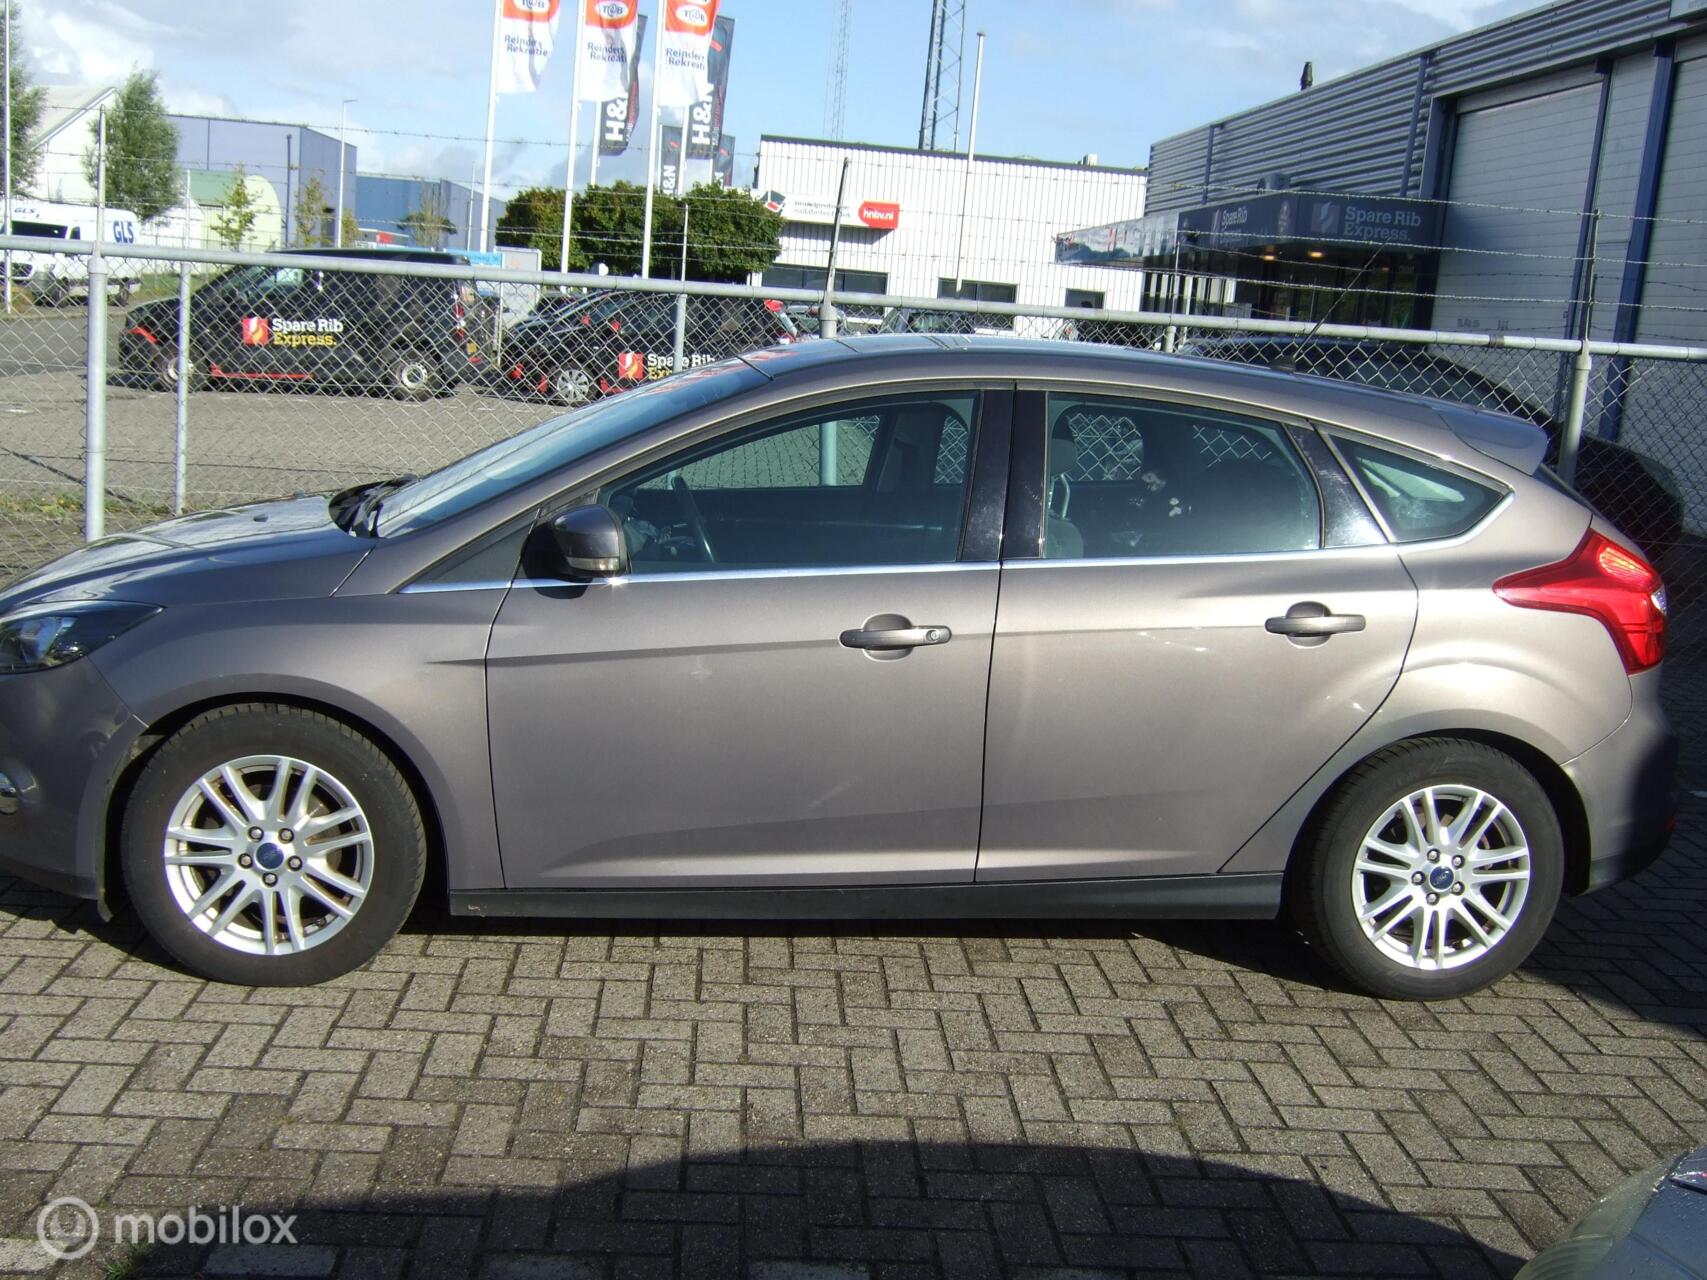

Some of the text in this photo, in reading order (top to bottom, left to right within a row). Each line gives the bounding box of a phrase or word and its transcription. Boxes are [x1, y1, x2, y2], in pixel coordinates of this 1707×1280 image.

[602, 3, 624, 17] T@B
[590, 51, 628, 63] Rekreati
[668, 56, 705, 71] Rekreati
[1344, 205, 1422, 227] Spare Rib
[112, 220, 135, 244] GLS
[271, 317, 345, 334] Spare Rib
[647, 353, 690, 369] Spae
